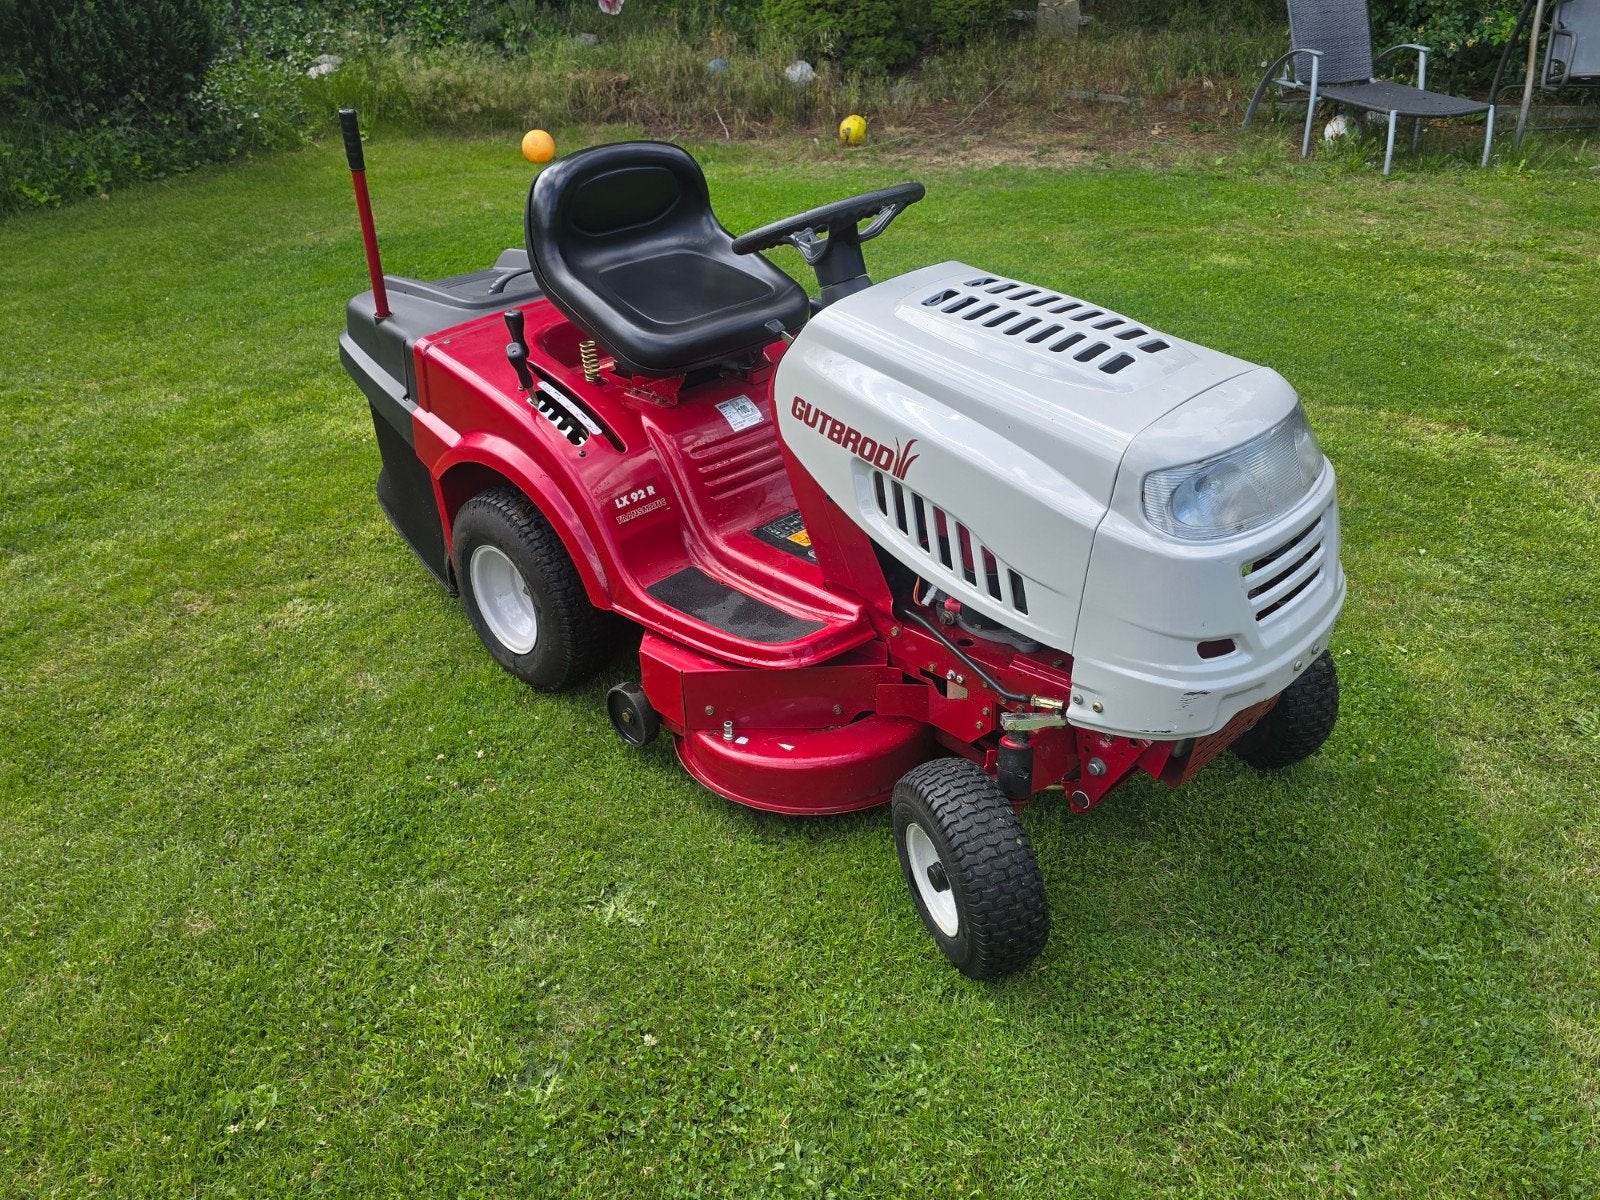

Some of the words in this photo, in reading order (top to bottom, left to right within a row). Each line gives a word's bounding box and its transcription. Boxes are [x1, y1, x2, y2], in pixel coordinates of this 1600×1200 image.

[791, 395, 895, 472] GUTBROD
[614, 494, 631, 509] LX
[630, 489, 647, 503] 92
[646, 485, 656, 496] R
